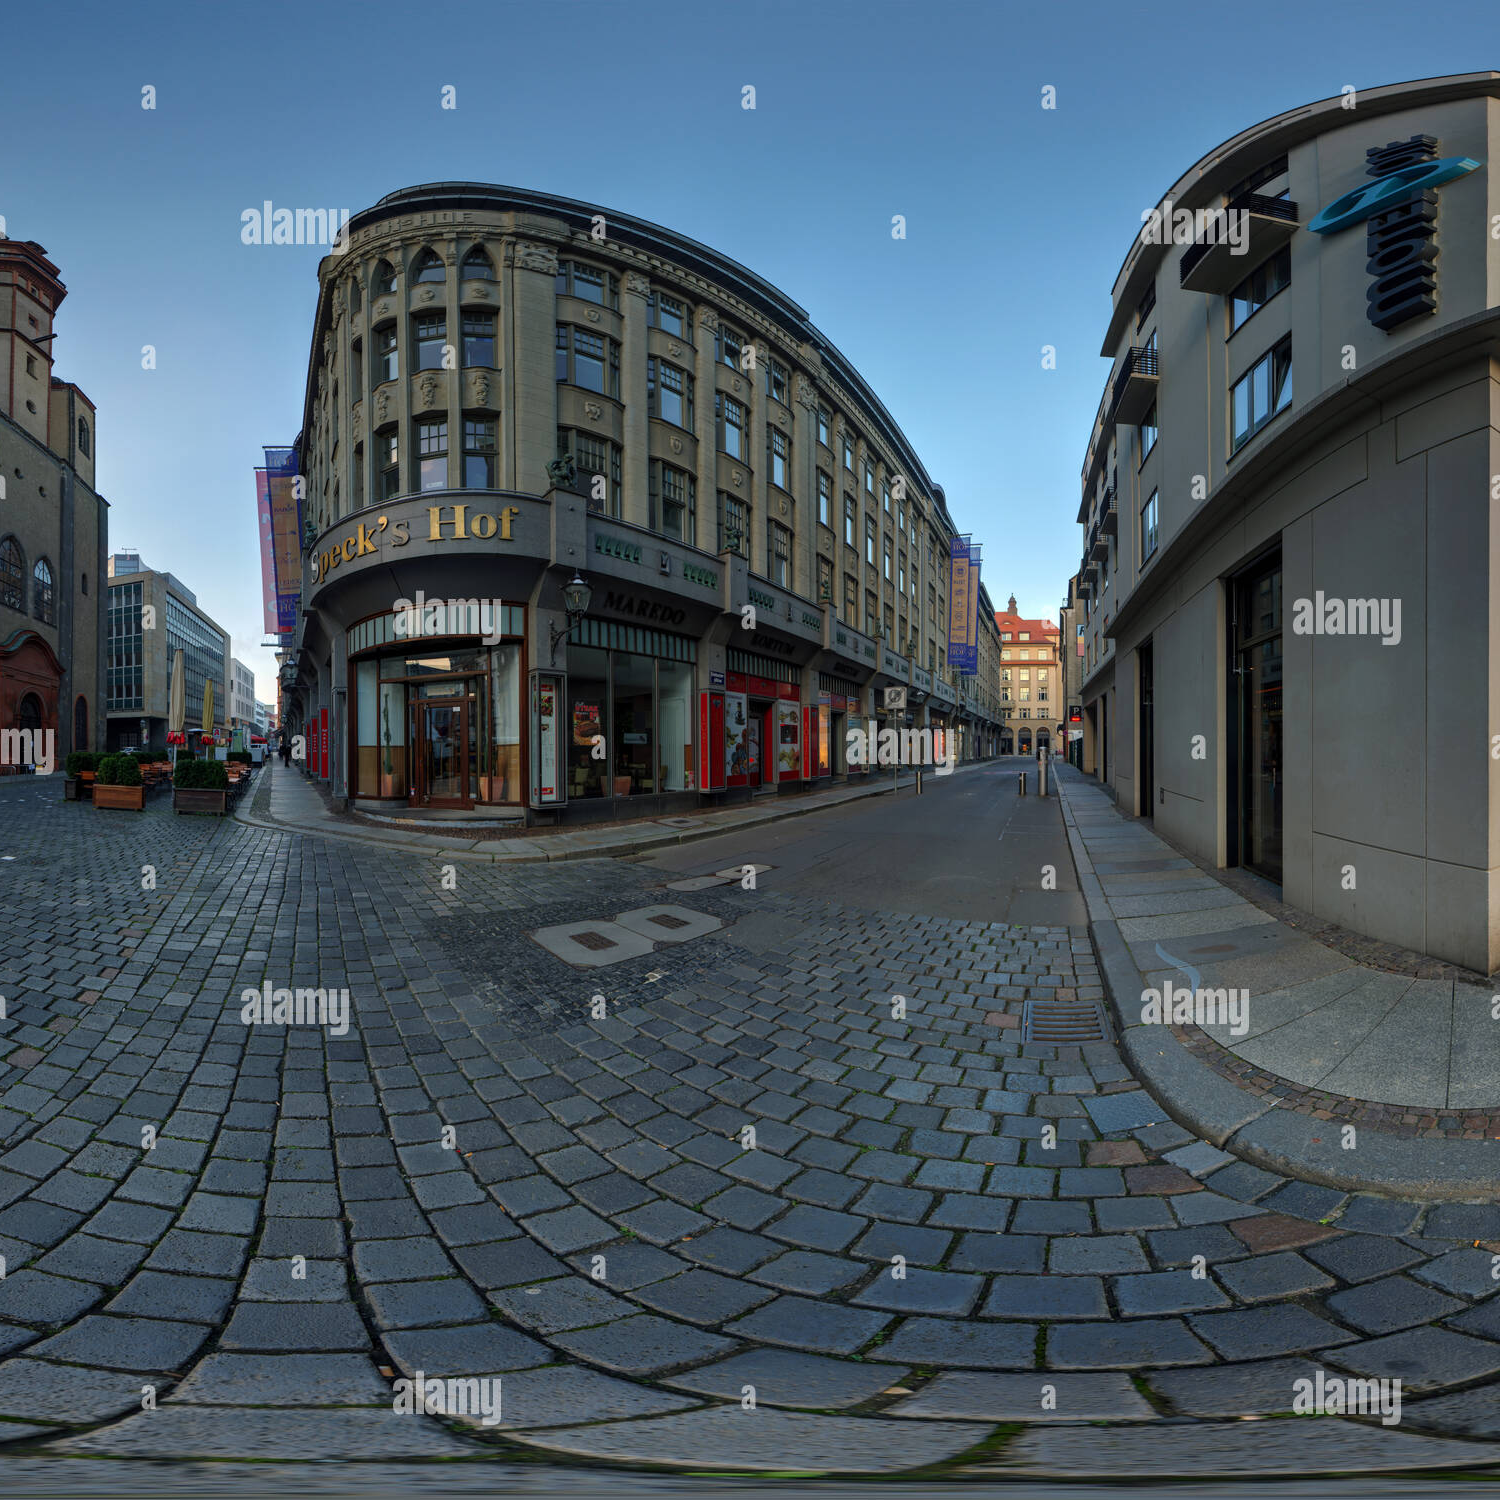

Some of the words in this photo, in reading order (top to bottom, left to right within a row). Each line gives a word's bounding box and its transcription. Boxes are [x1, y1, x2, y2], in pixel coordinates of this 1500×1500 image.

[310, 516, 410, 583] Speck's
[426, 504, 519, 541] Hof
[603, 591, 685, 625] MAREDO
[1073, 706, 1080, 714] P
